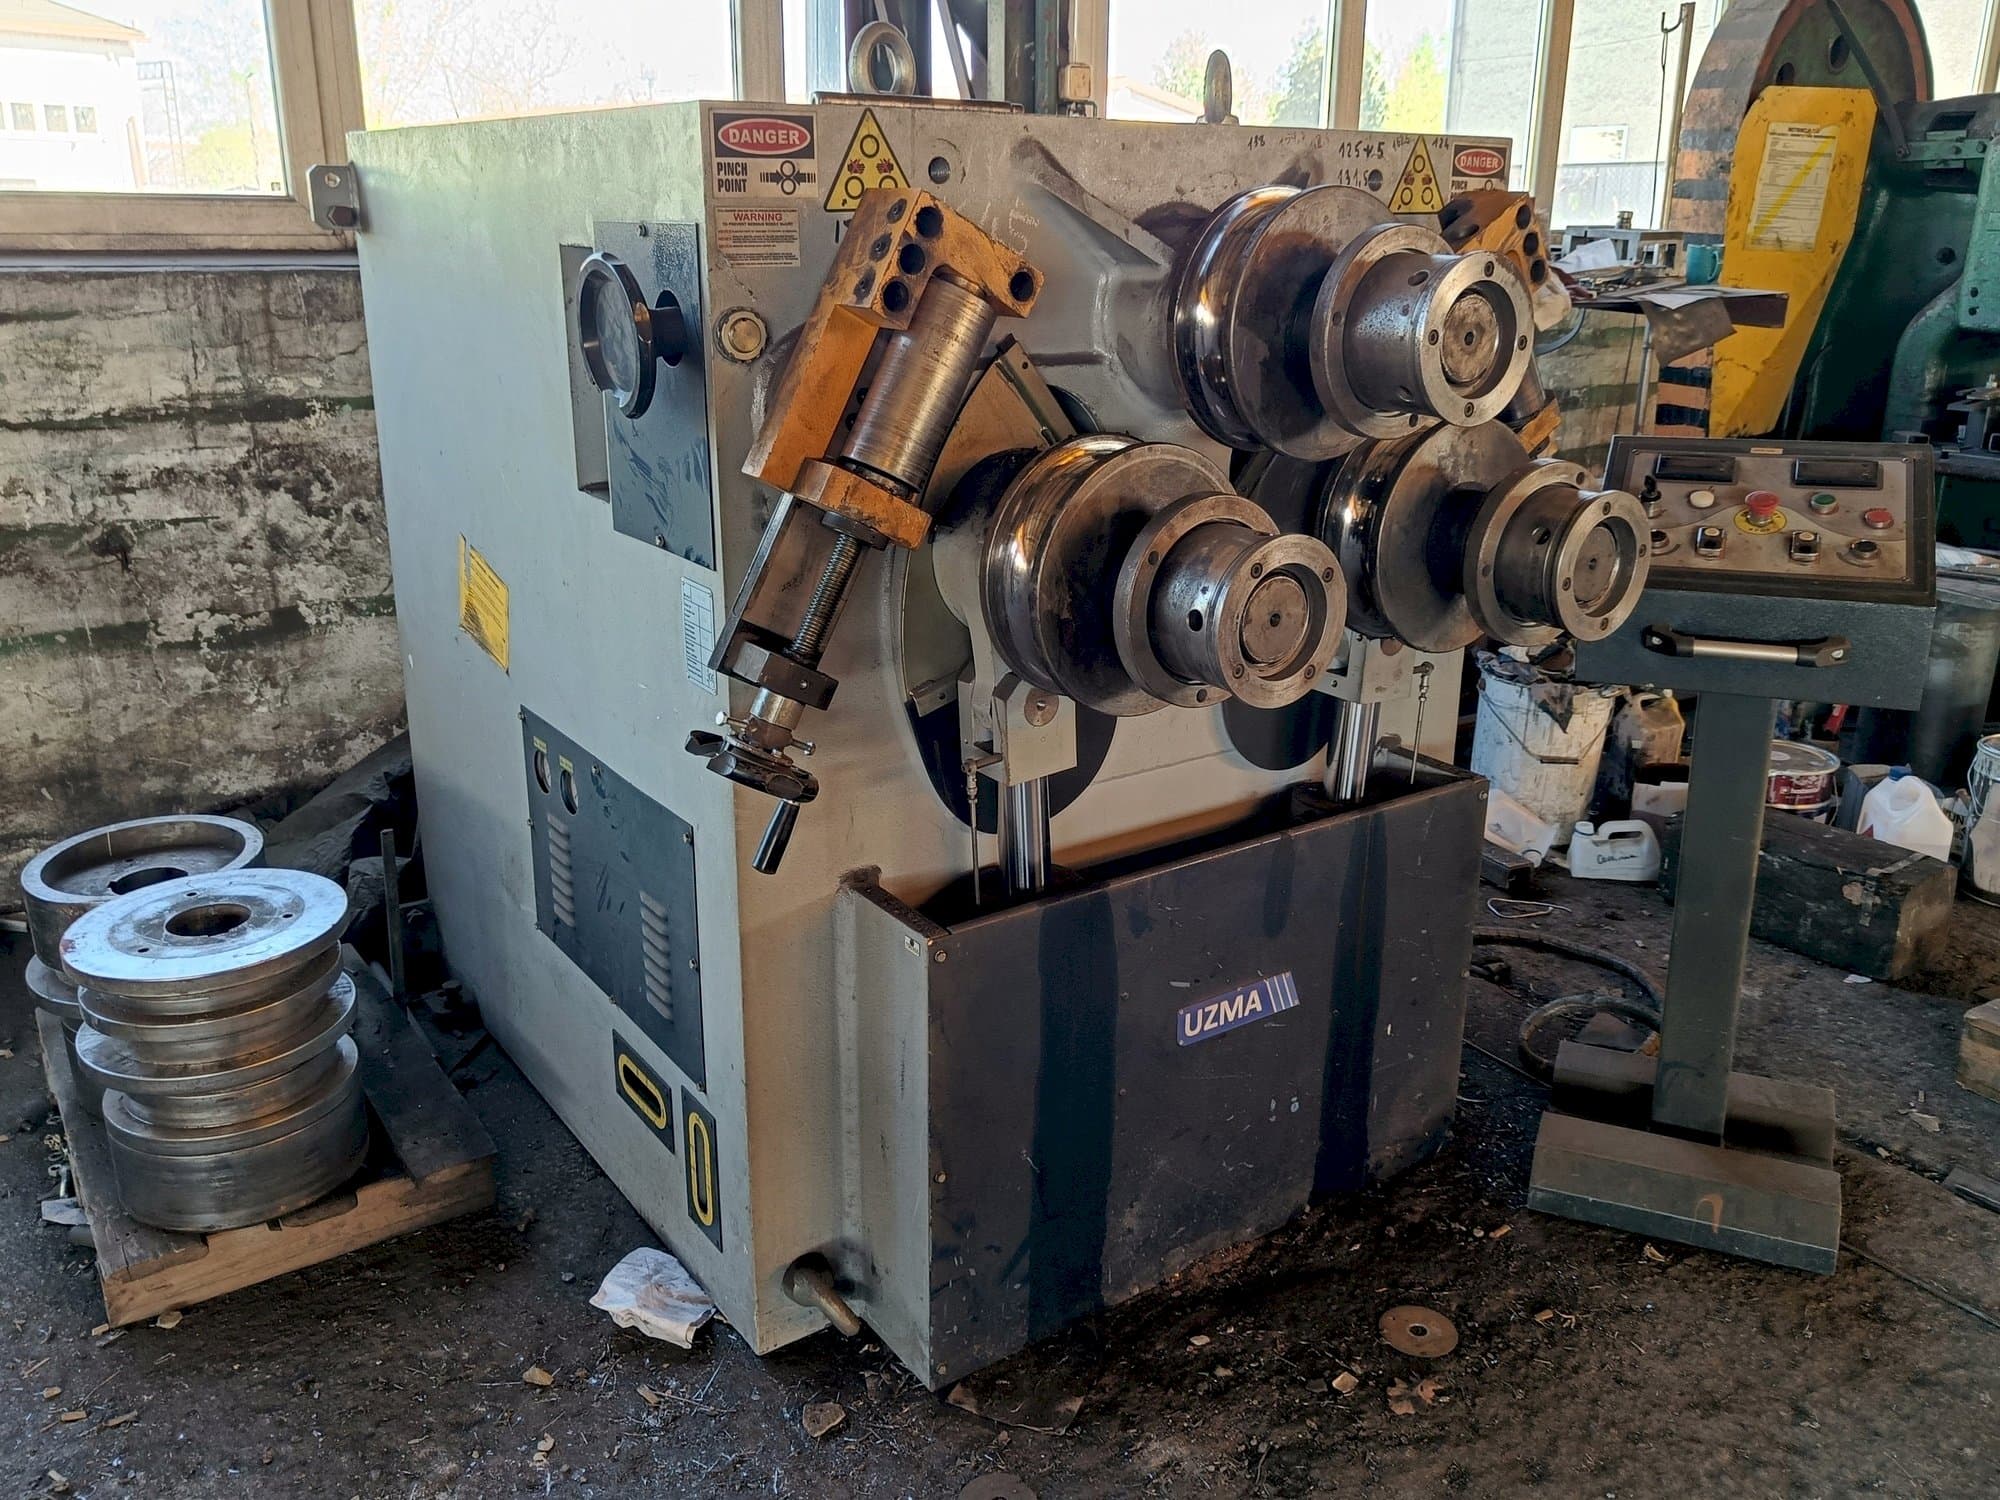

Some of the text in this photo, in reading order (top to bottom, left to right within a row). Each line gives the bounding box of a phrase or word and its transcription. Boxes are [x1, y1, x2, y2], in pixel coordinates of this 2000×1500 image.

[728, 128, 800, 145] DANGER
[717, 162, 748, 177] PINCH
[1460, 155, 1499, 169] DANGER
[718, 178, 747, 193] POINT
[733, 212, 783, 222] WARNING
[1184, 990, 1263, 1037] UZMA
